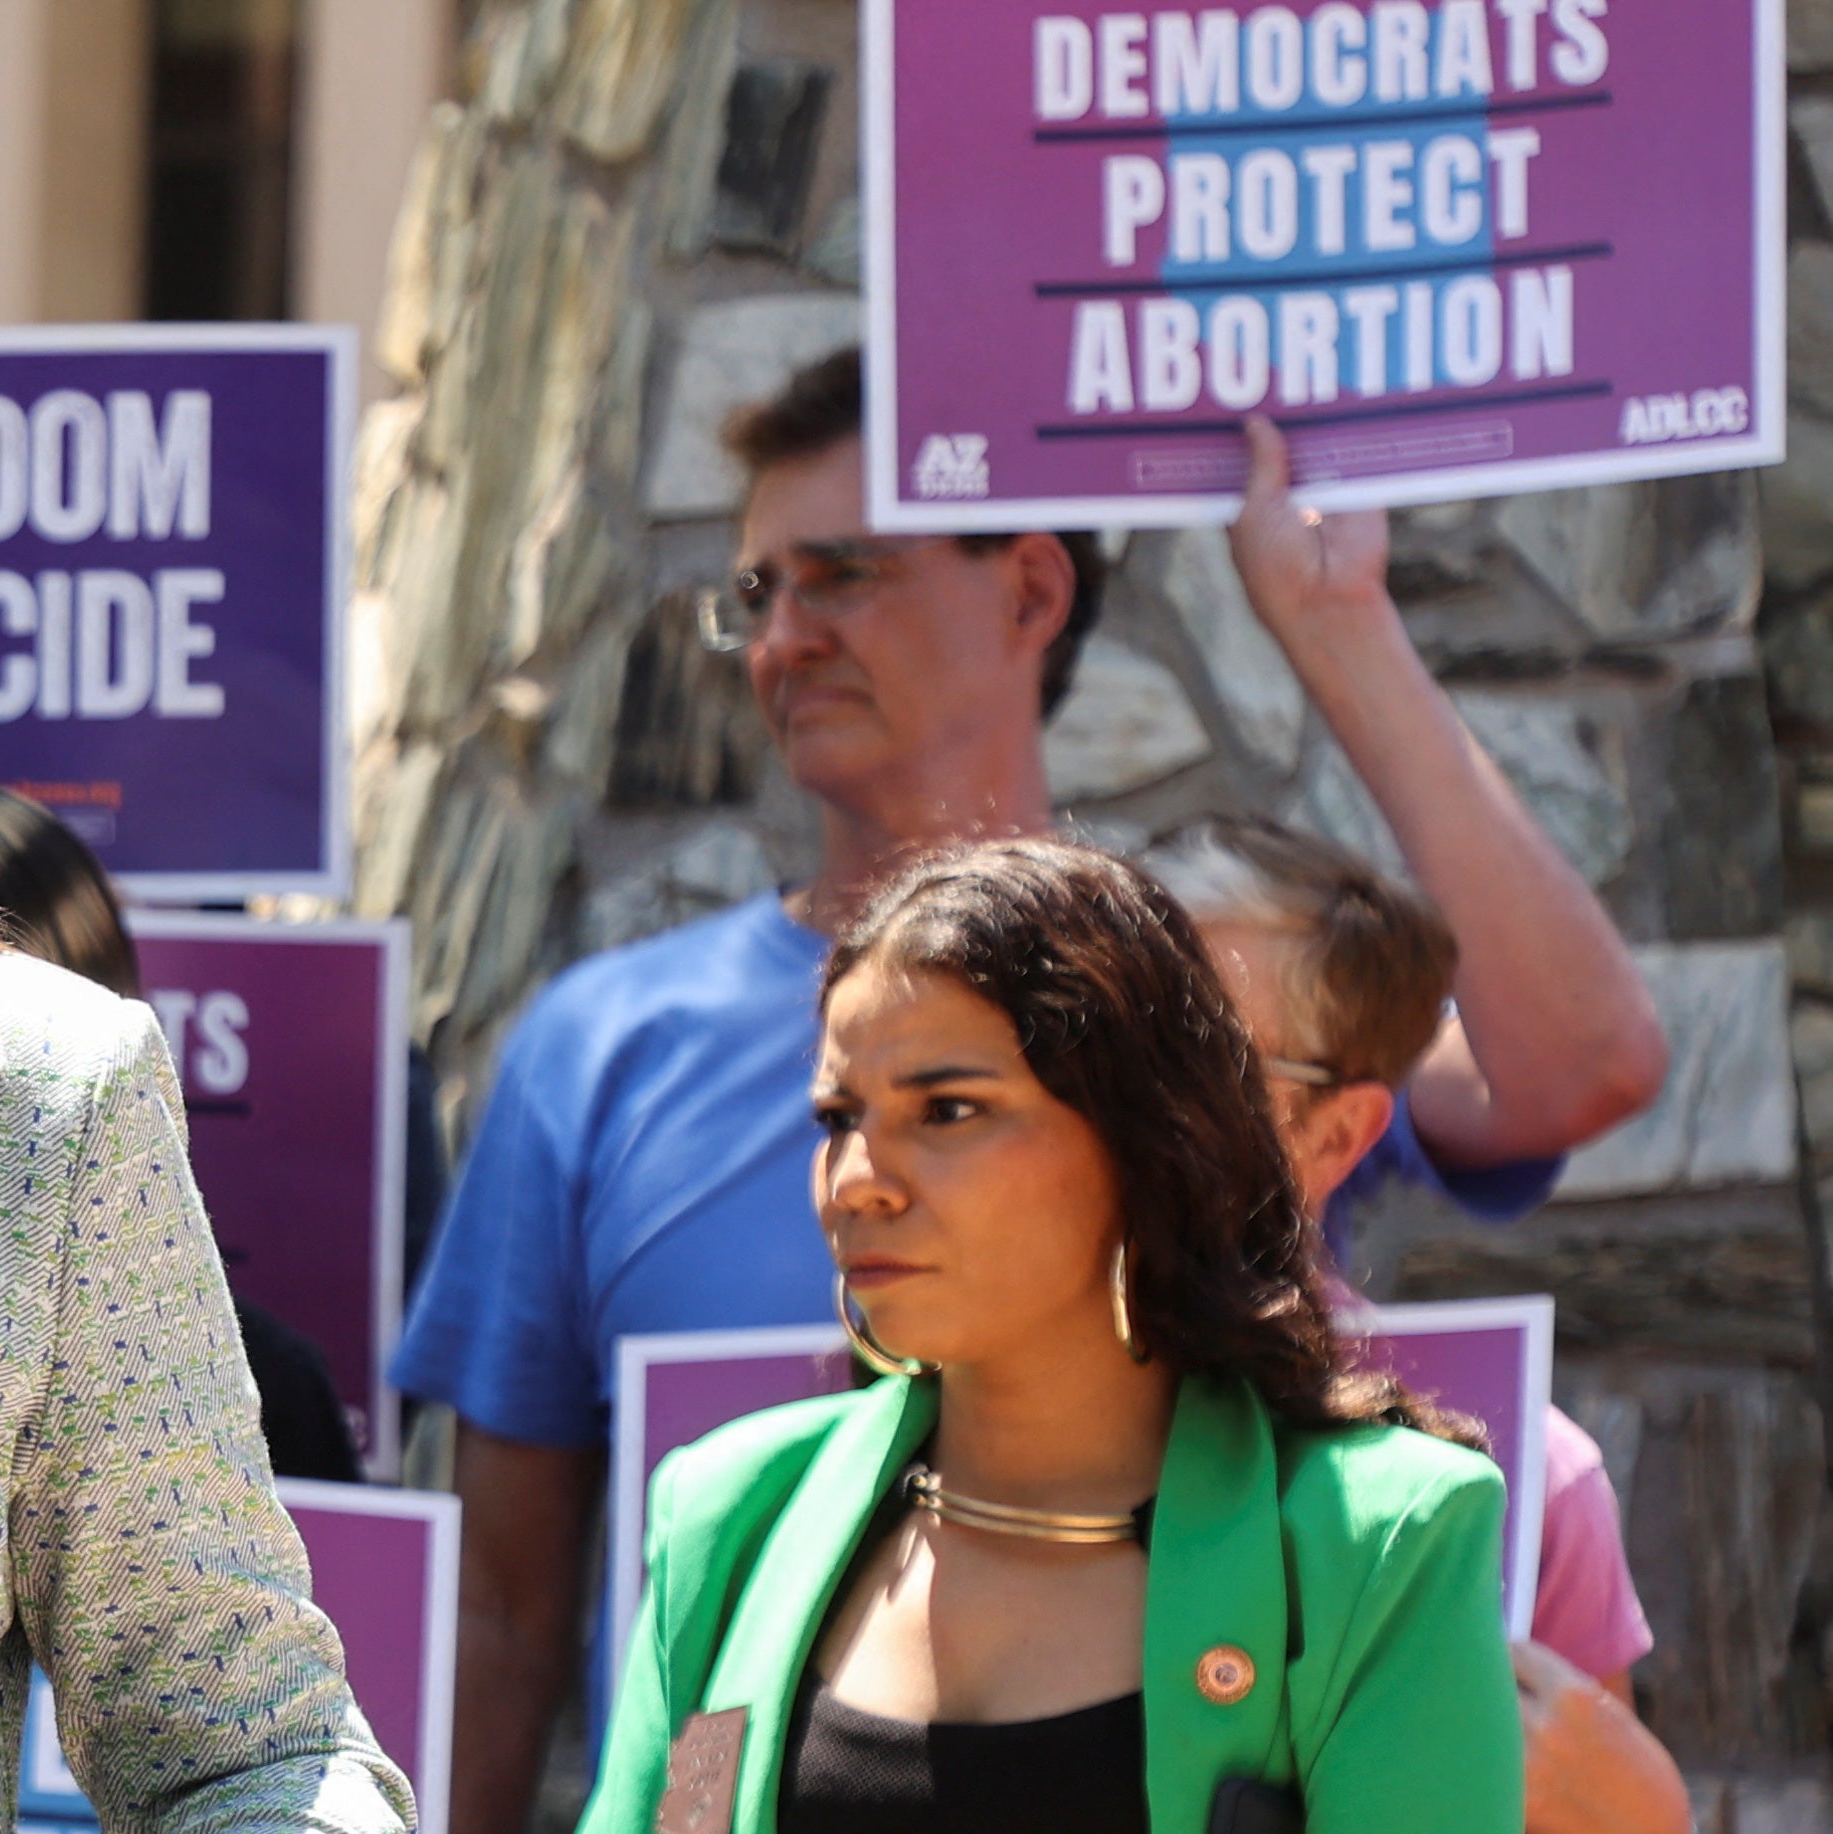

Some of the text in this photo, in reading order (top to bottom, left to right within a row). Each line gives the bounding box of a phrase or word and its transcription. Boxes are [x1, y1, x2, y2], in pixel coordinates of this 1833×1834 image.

[1035, 0, 1610, 121] DEMOCRATS
[1103, 129, 1541, 266] PROTECT
[1070, 267, 1575, 415] ABORTION
[1620, 385, 1749, 446] ADLCC
